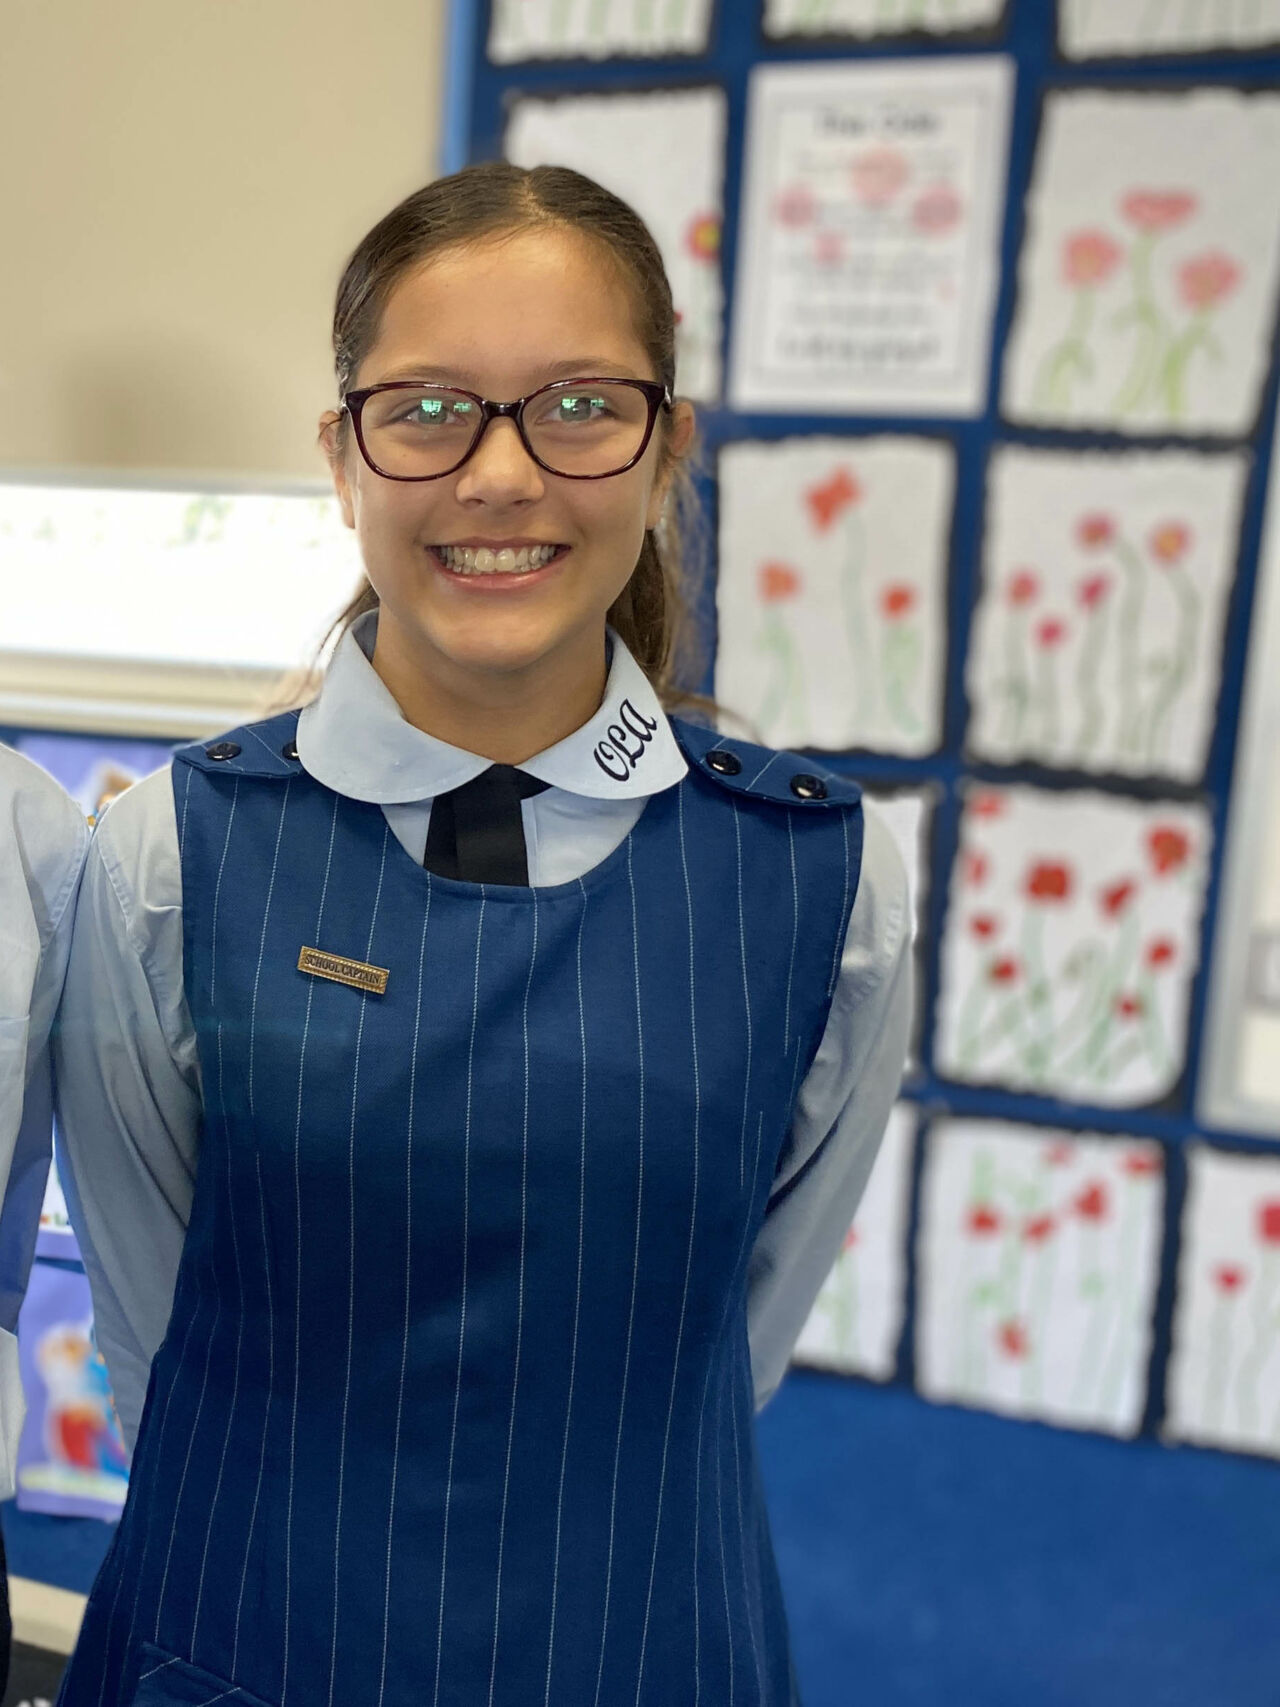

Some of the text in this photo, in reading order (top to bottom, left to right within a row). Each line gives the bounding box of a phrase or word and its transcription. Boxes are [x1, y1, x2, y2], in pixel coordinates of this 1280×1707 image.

[593, 698, 658, 782] OLA
[304, 954, 380, 985] SCHOOL CAPTAIN
